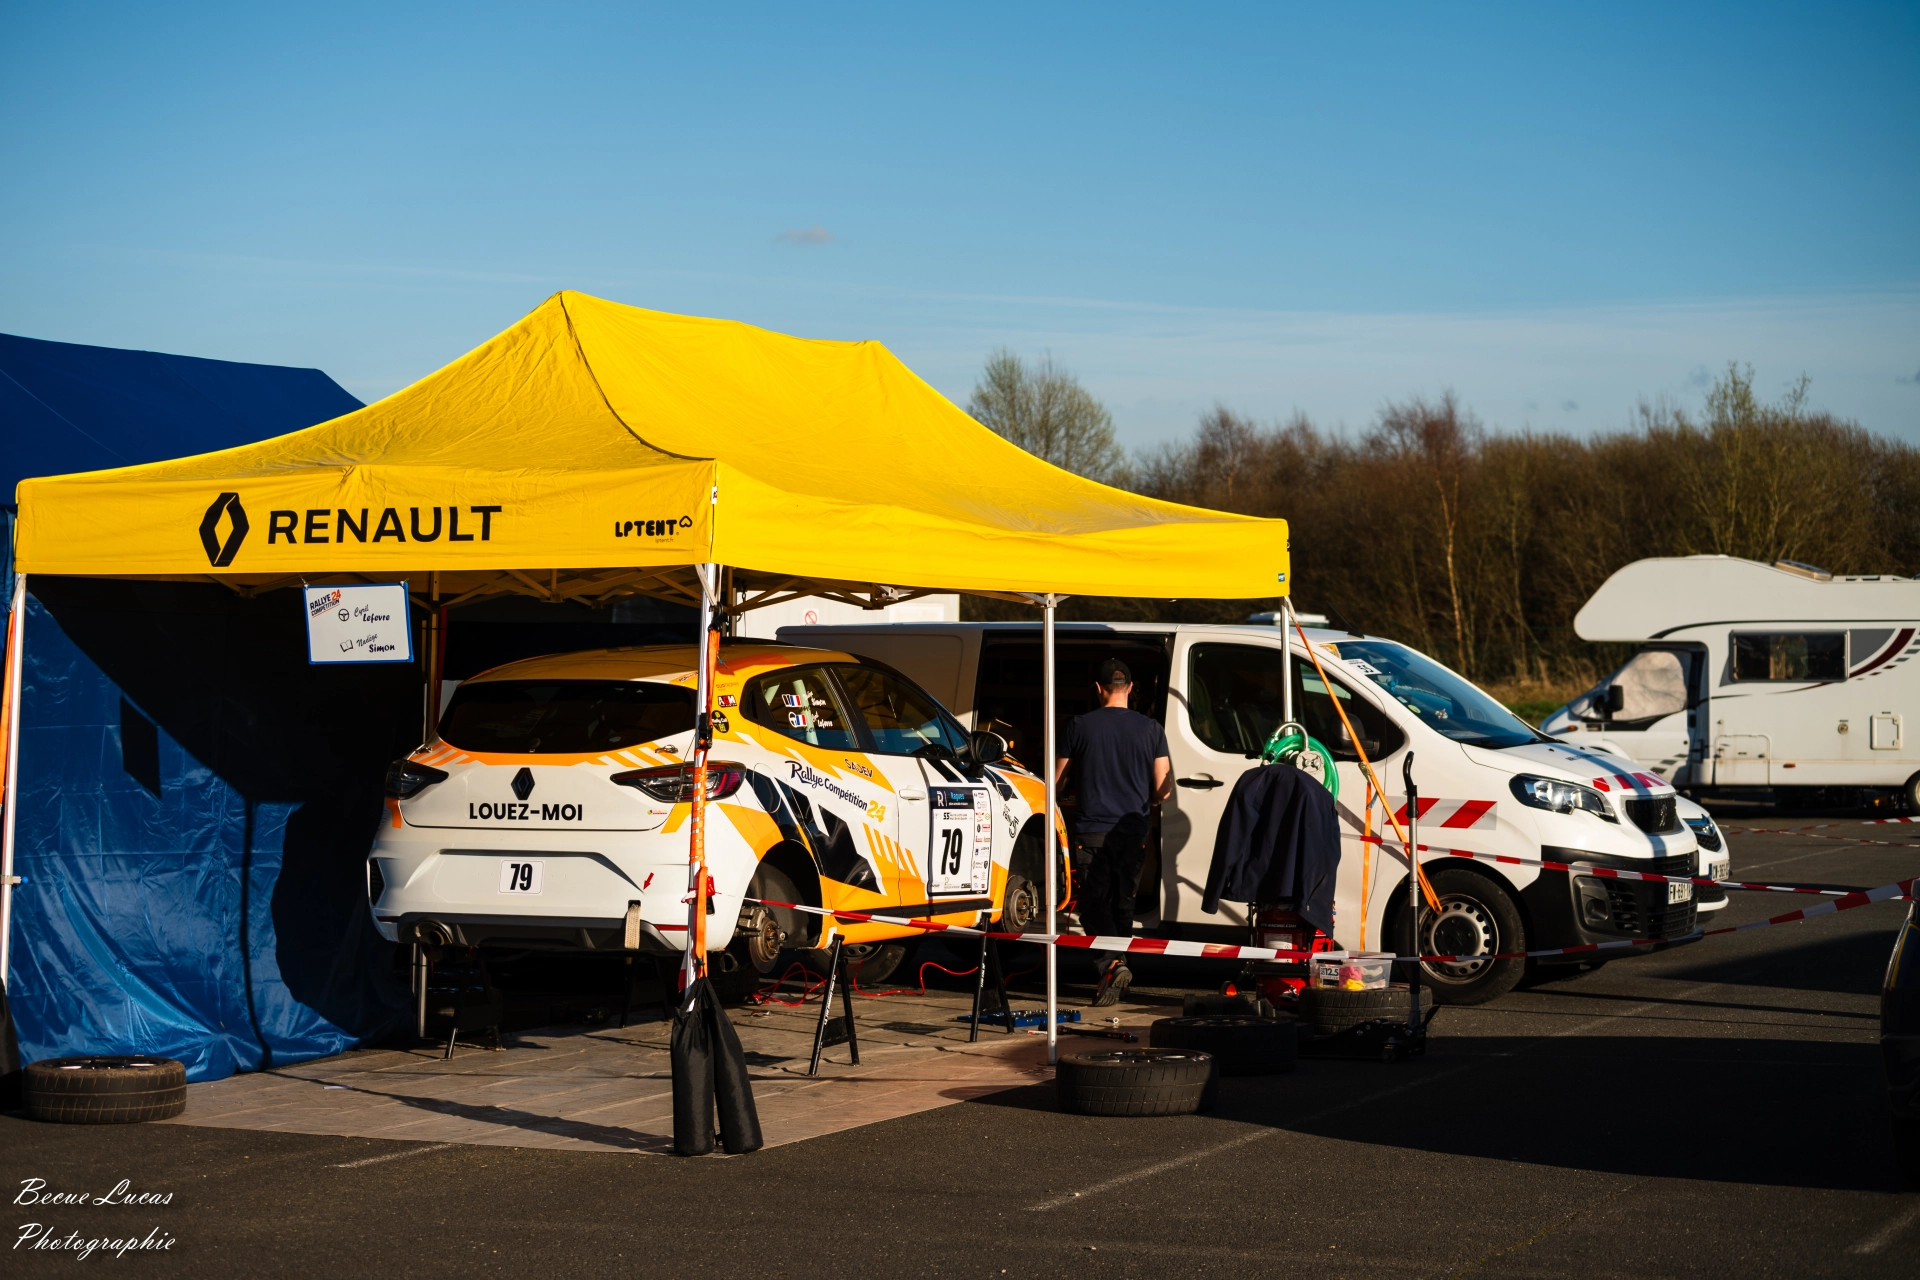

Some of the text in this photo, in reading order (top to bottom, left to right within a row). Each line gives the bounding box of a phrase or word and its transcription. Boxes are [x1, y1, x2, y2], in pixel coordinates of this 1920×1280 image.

[267, 505, 502, 545] RENAULT
[615, 519, 678, 538] LPTENT
[310, 589, 342, 611] RALLYE 24
[311, 599, 340, 616] COMPETITION
[353, 604, 369, 617] Cyril
[362, 613, 390, 623] Lefevre
[368, 643, 395, 653] Simon
[784, 760, 887, 823] Rallye Compétition 24
[469, 802, 583, 821] LOUEZ-MOI
[940, 827, 963, 876] 79
[509, 863, 533, 891] 79
[1324, 967, 1339, 977] 12.5
